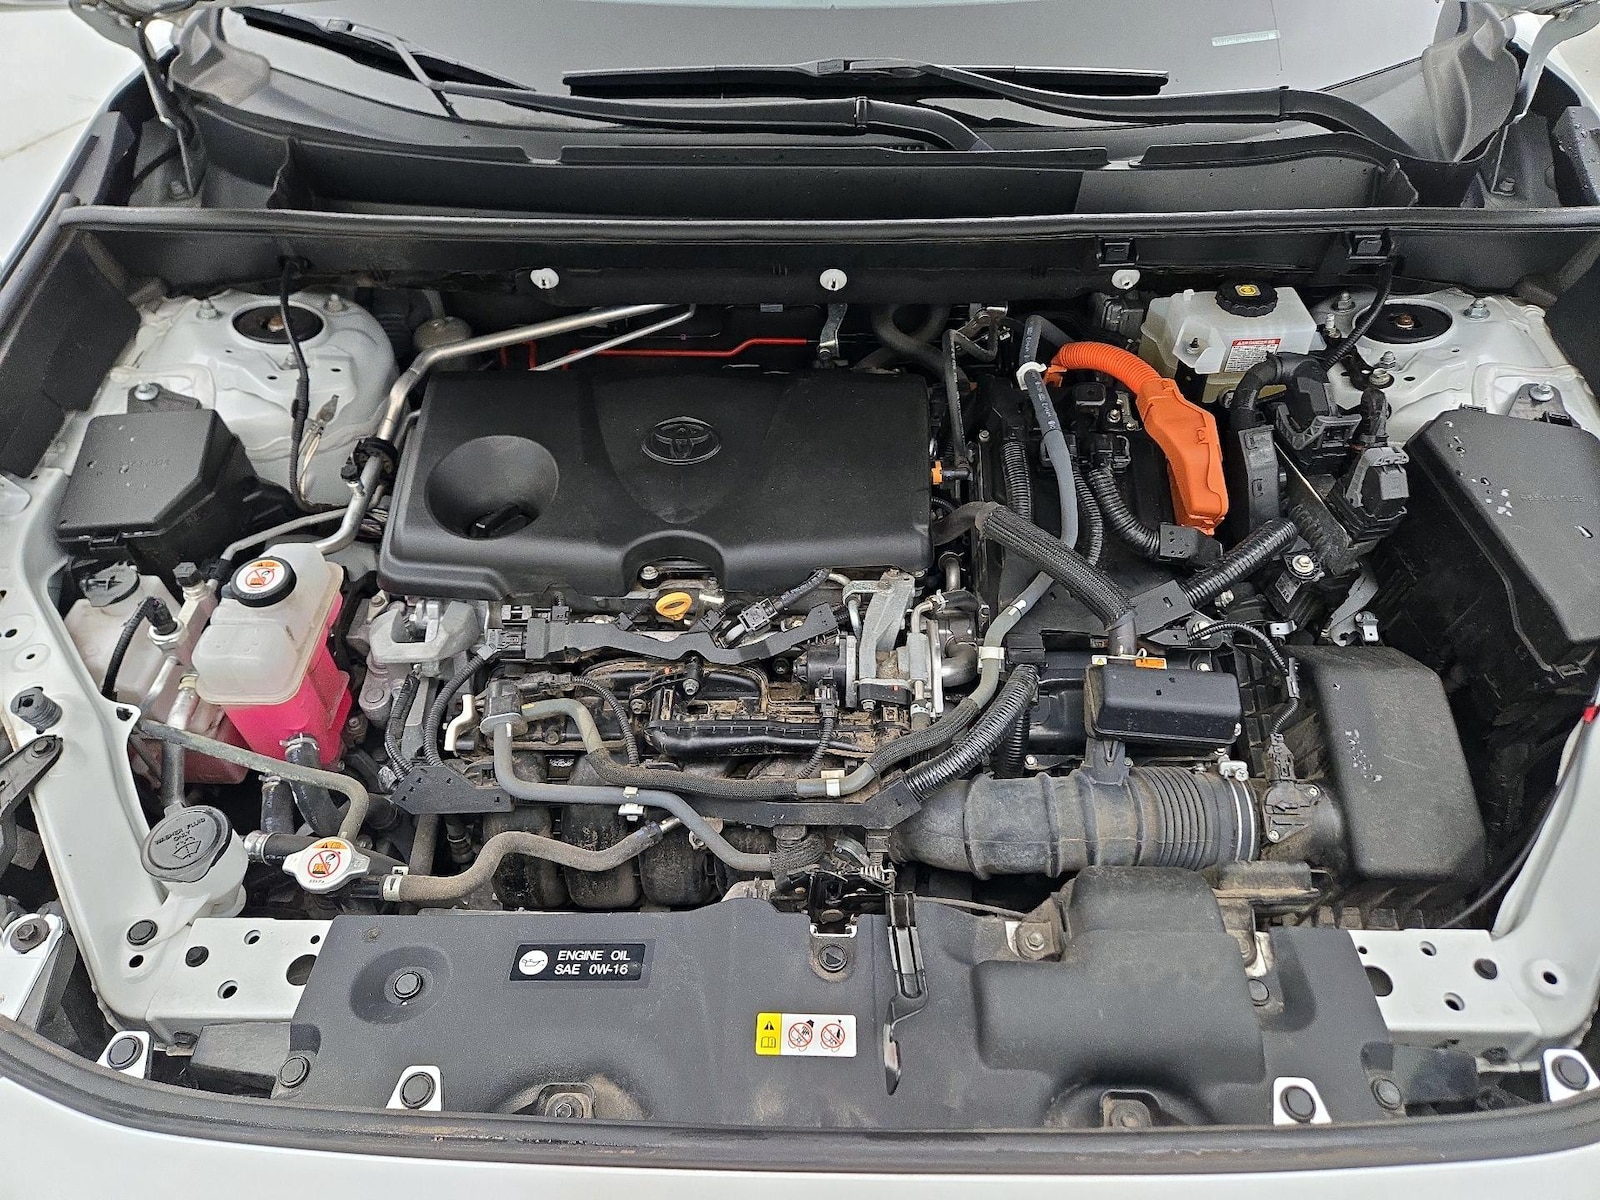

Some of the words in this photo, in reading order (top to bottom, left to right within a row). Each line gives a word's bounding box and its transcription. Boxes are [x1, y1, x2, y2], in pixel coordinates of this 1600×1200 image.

[154, 828, 183, 845] WASHER
[186, 817, 206, 829] FLUID
[173, 829, 191, 841] ONLY
[557, 950, 604, 961] ENGINE
[610, 950, 631, 961] OIL
[554, 964, 581, 975] SAE
[588, 963, 629, 975] 0W-16
